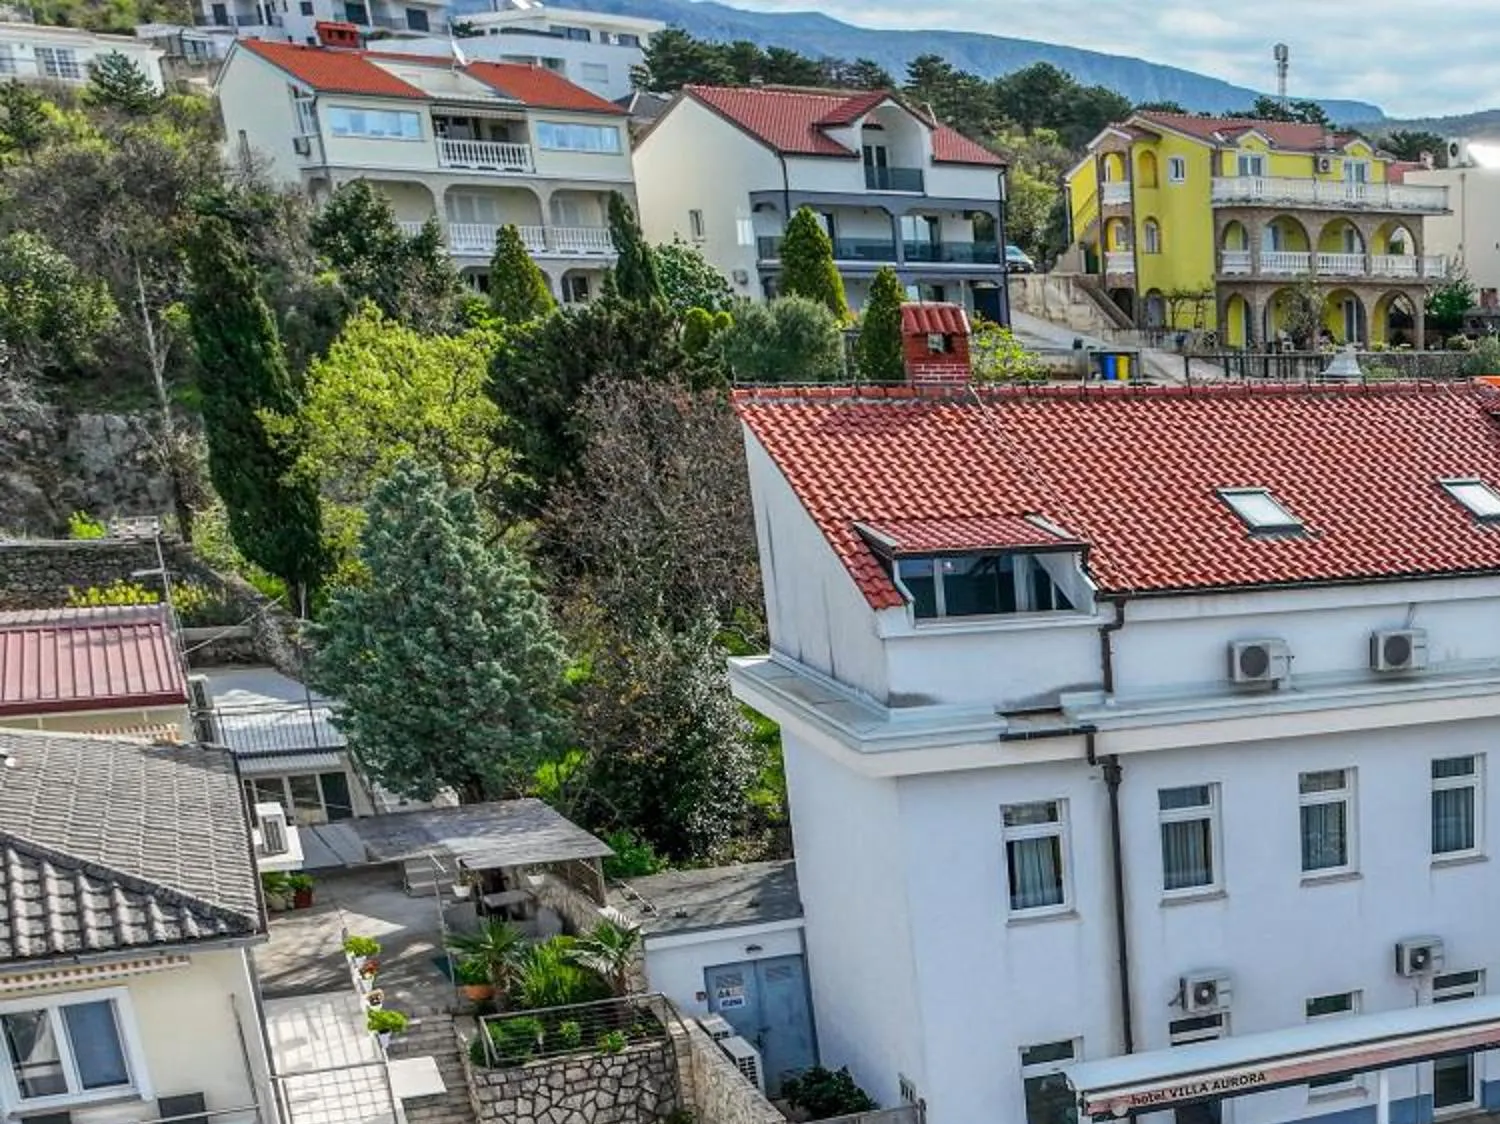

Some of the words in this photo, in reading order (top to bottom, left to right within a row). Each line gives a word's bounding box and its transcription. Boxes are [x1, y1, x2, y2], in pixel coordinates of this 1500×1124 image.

[1131, 1090, 1166, 1105] hotel
[1169, 1081, 1210, 1098] VILLA
[1212, 1071, 1266, 1091] AURORA
